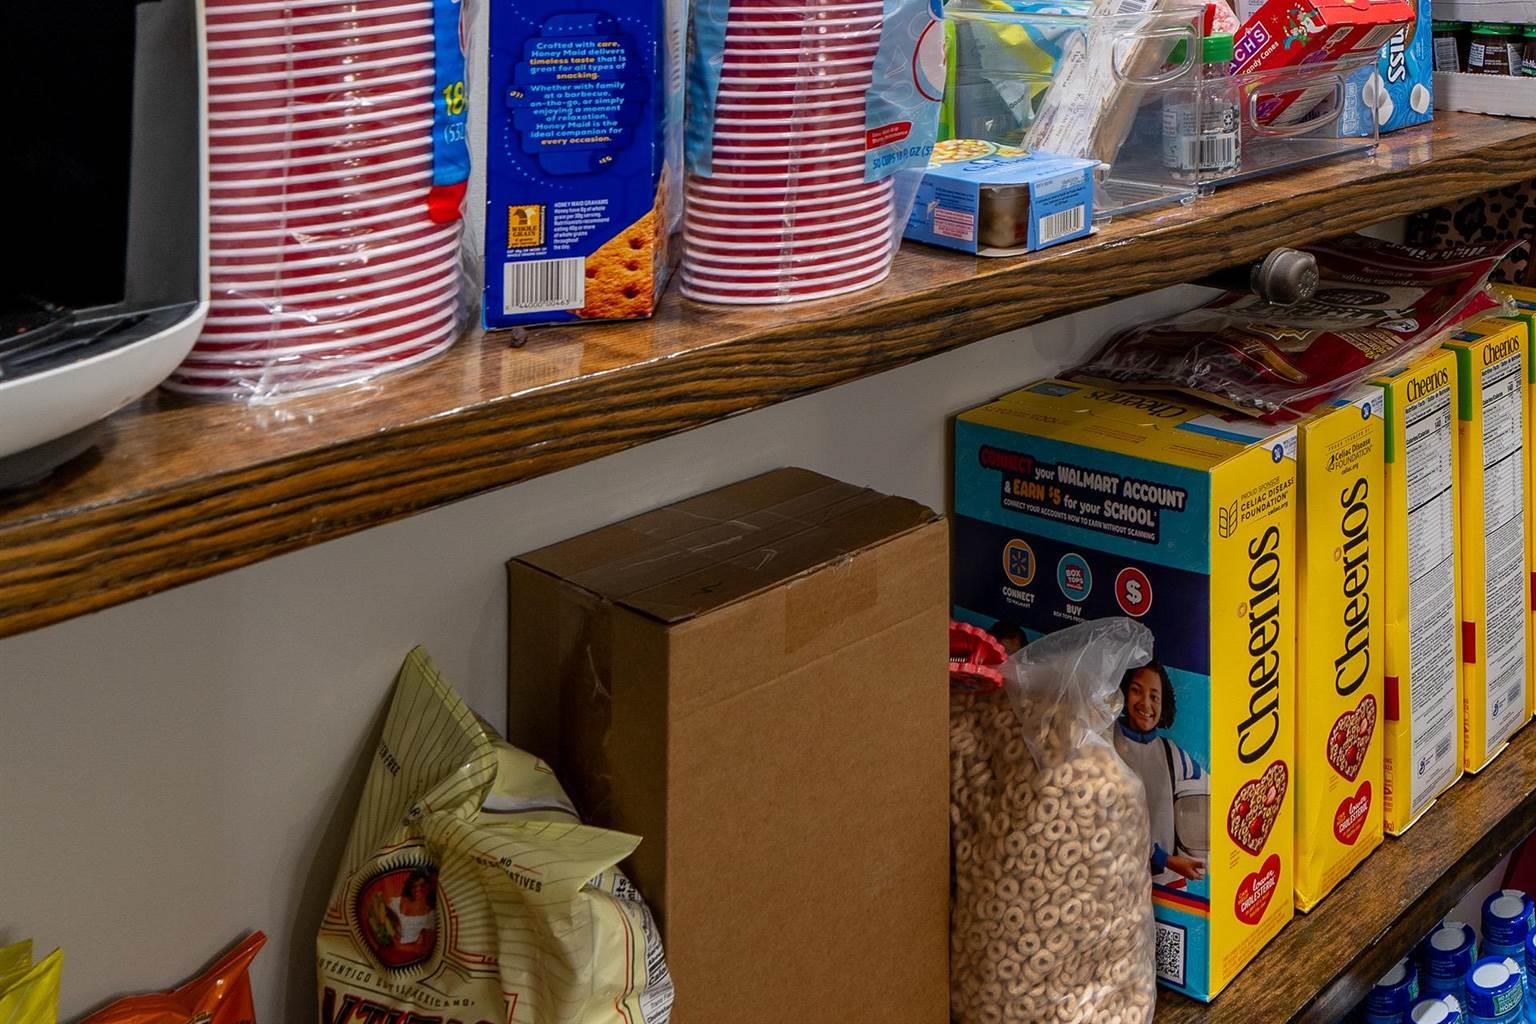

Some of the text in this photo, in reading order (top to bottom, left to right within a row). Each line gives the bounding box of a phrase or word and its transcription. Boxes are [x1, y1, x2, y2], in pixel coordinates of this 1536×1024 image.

[531, 50, 561, 58] Honey
[530, 66, 556, 75] great
[558, 64, 572, 72] for
[588, 64, 613, 72] types
[530, 84, 572, 92] Whether
[596, 81, 625, 90] family
[533, 106, 573, 115] enjoying
[531, 130, 554, 138] ideal
[556, 128, 607, 137] companion
[536, 122, 566, 130] Honey
[1482, 334, 1521, 366] Cheerios
[1406, 367, 1450, 403] Cheerios
[1335, 447, 1352, 461] Celiac
[1351, 438, 1372, 453] Disease
[1335, 444, 1373, 471] FOUNDATION
[979, 446, 1186, 509] CONNECT your WALMART ACCOUNT
[1240, 476, 1280, 501] PROUD SPONSOR
[1004, 482, 1011, 494] &
[1013, 478, 1045, 502] EARN
[1048, 484, 1062, 506] $5
[1063, 494, 1078, 509] for
[1079, 500, 1101, 515] your
[1240, 476, 1295, 512] CELIAC DISEASE
[1240, 491, 1289, 522] FOUNDATION
[1003, 498, 1156, 541] CONNECT YOUR ACCOUNTS NOW TO EARN WITHOUT SCANNING
[1065, 569, 1081, 577] BOX
[1068, 576, 1083, 585] TOPS
[1002, 585, 1036, 604] CONNECT
[1335, 477, 1369, 698] Cheerios
[1065, 602, 1082, 616] BUY
[1237, 525, 1281, 765] Cheerios
[1349, 795, 1367, 815] lower
[1338, 801, 1369, 833] CHOLESTEROL
[499, 856, 513, 868] NO
[1252, 869, 1275, 892] lower
[1240, 875, 1276, 913] CHOLESTEROL
